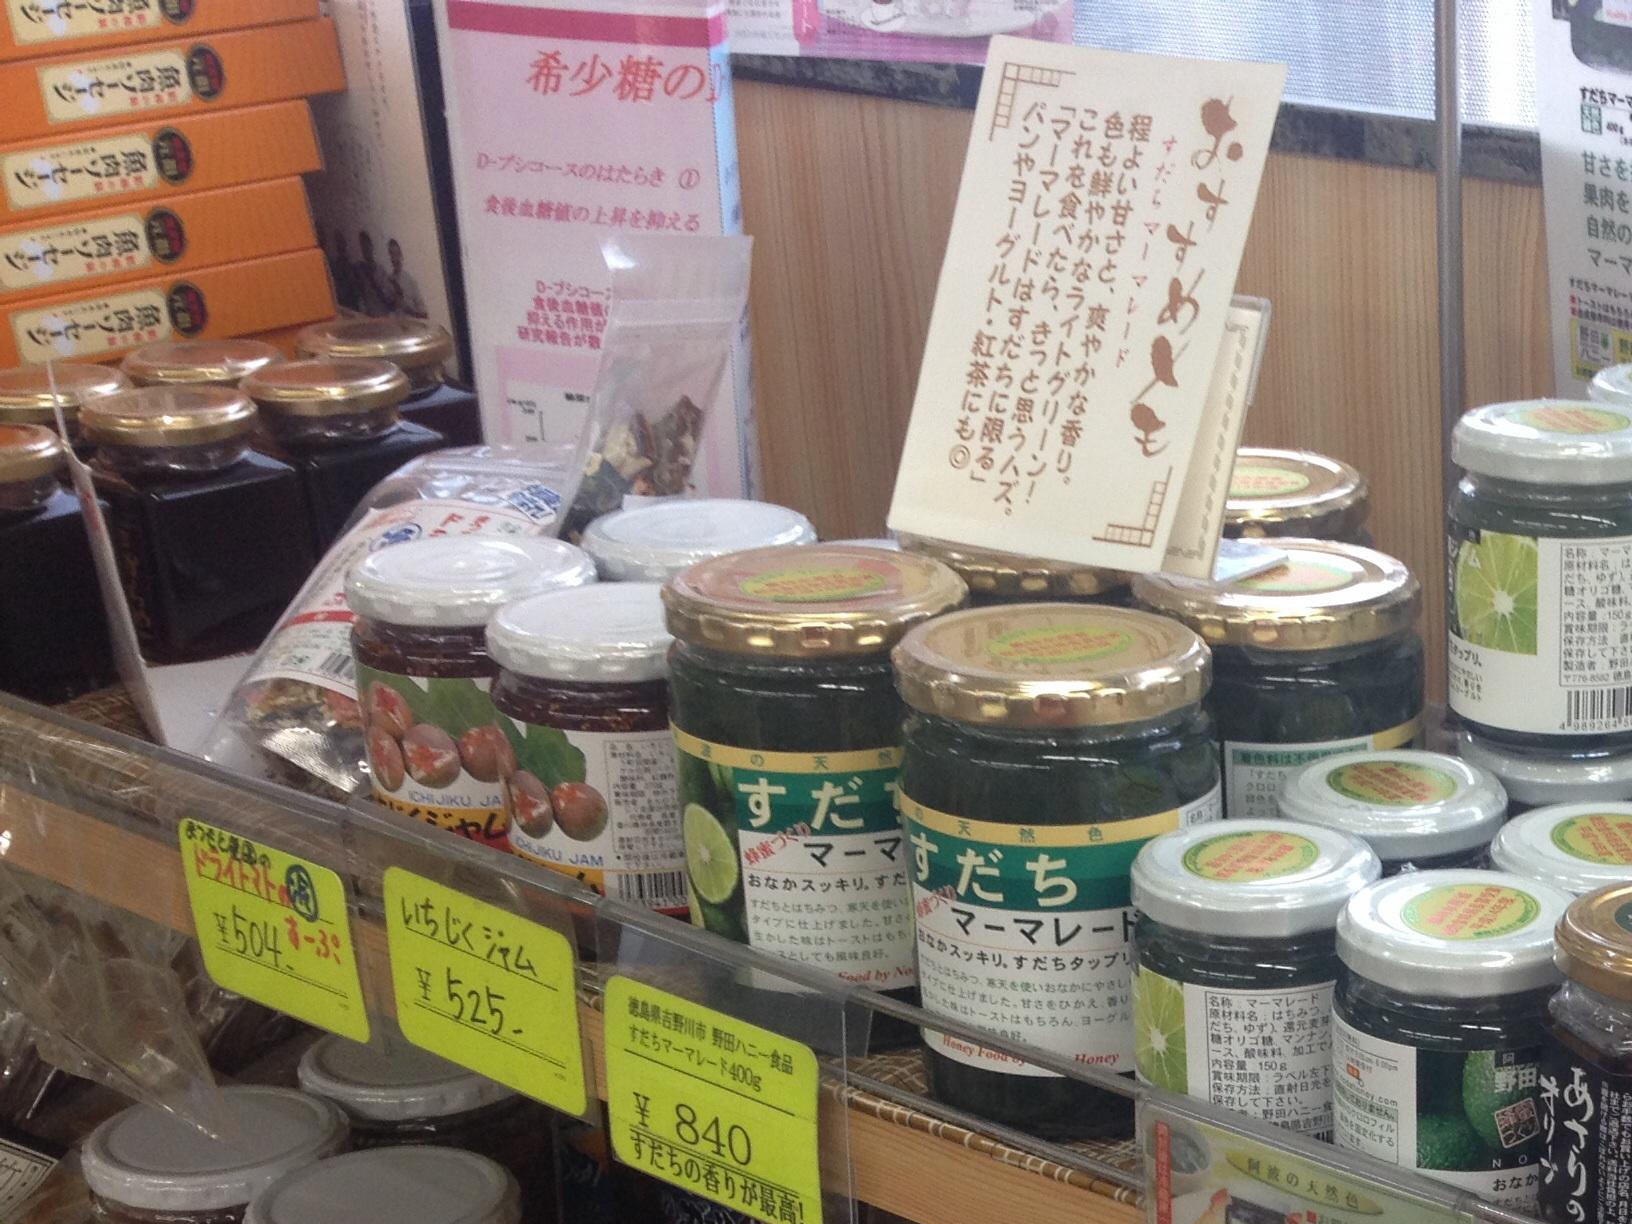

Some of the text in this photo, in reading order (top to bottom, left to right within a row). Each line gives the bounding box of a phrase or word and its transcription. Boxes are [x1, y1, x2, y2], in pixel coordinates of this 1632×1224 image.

[526, 50, 719, 102] 希少糖の
[567, 852, 605, 869] JAM
[910, 832, 1078, 908] すだち
[400, 896, 538, 977] いちじくジャム
[627, 996, 794, 1076] 徳島県吉野川市 野田ハニー食品
[1074, 1051, 1120, 1066] Honey
[674, 1103, 752, 1167] 840
[1563, 1067, 1595, 1223] あさりの
[1247, 1157, 1360, 1211] 阿波の天然色
